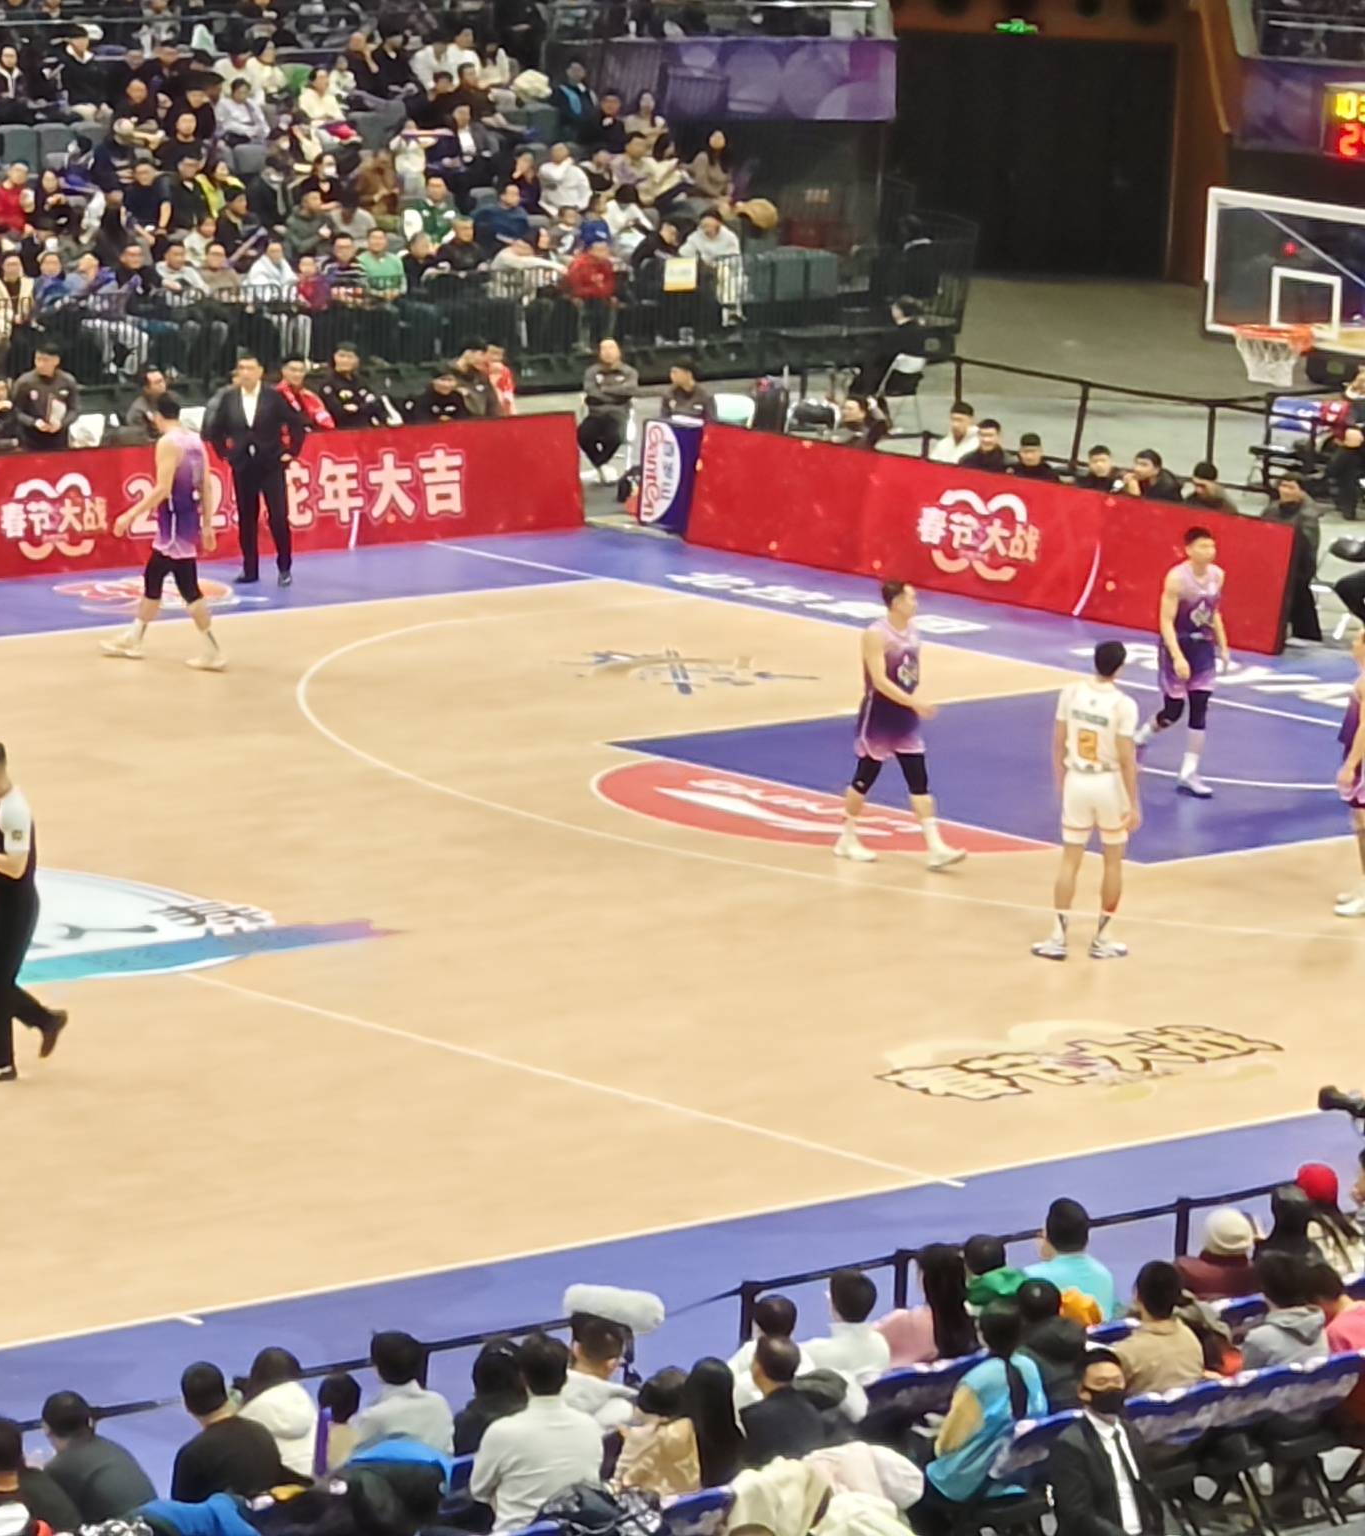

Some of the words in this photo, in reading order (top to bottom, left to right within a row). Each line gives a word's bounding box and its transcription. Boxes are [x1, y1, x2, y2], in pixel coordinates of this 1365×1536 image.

[0, 468, 109, 537] 春节大战
[917, 506, 1040, 564] 春节大战
